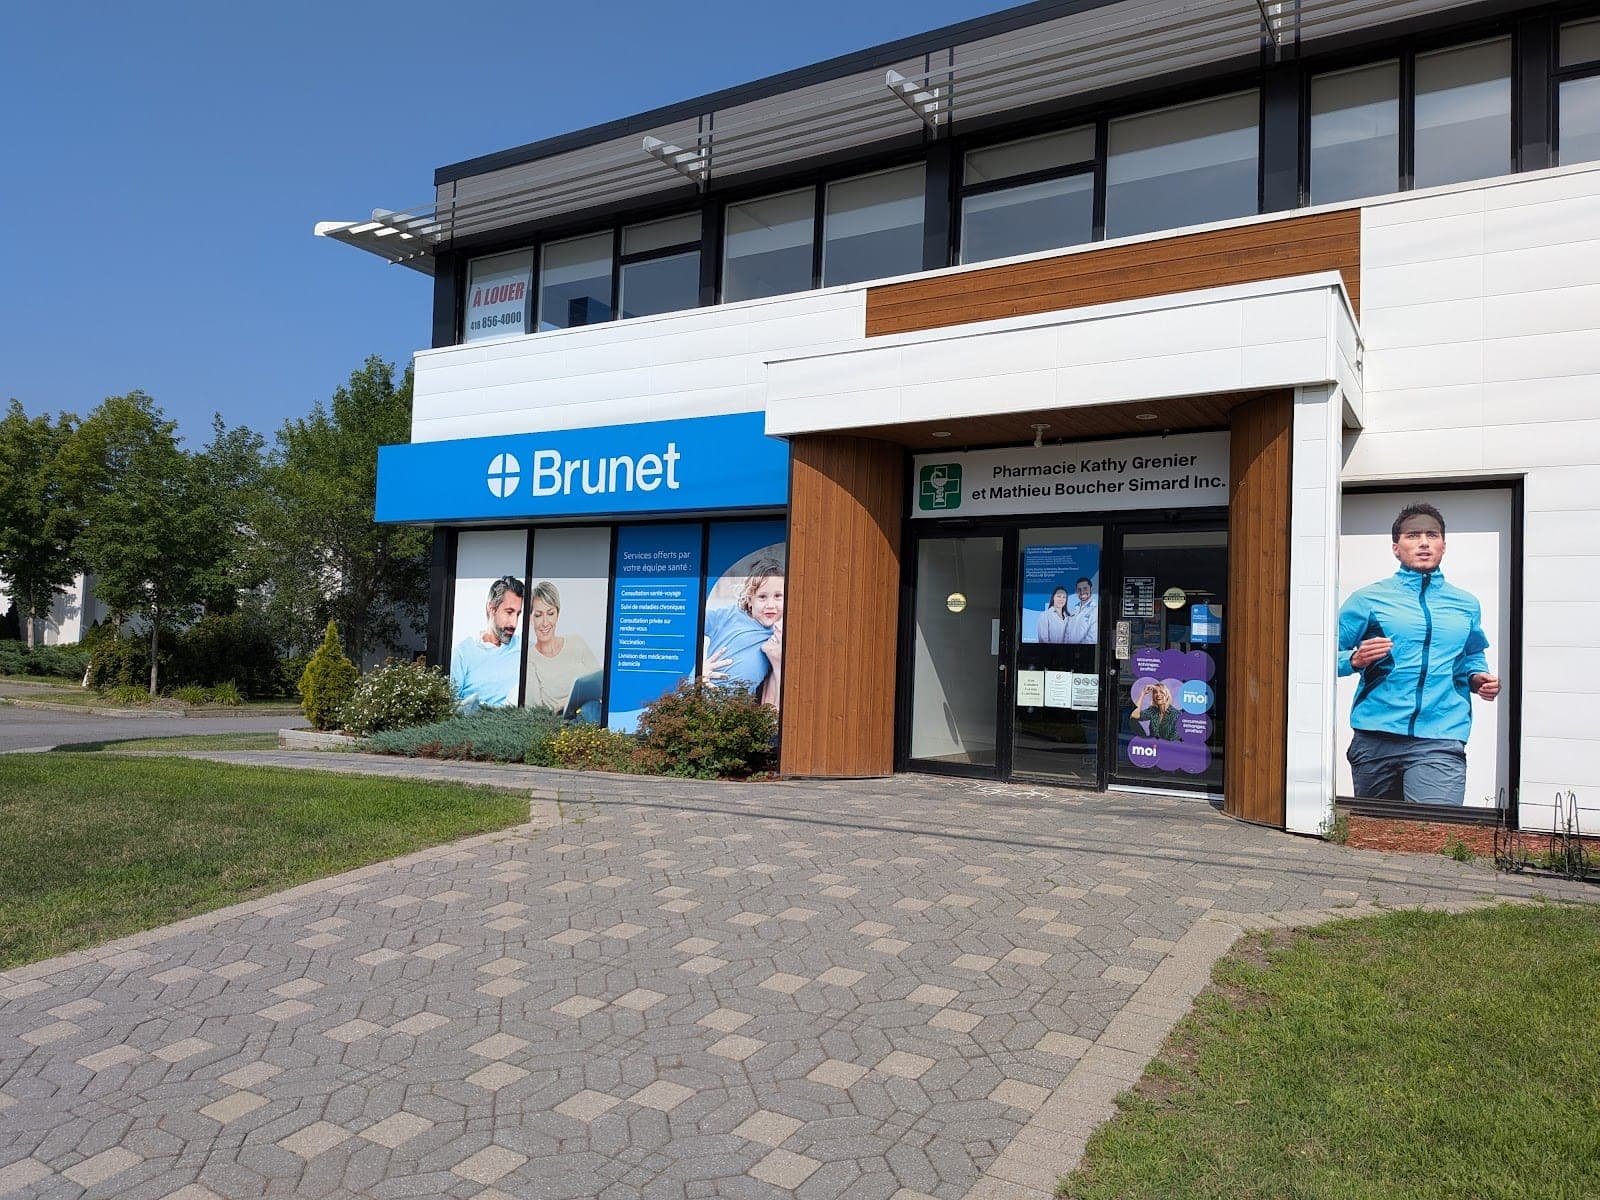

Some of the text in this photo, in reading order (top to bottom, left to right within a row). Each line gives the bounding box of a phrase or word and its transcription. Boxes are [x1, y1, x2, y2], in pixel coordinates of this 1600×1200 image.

[472, 281, 525, 308] À LOUER
[482, 311, 522, 329] 856-4000
[532, 442, 681, 497] Brunet
[992, 453, 1198, 479] Pharmacie Kathy Grenier
[971, 474, 1226, 500] et Mathieu Boucher Simard Inc.
[623, 550, 691, 560] Services offerts par
[623, 564, 641, 572] votre
[642, 563, 667, 573] équipe
[667, 563, 688, 571] santé
[1183, 693, 1209, 705] moi
[1131, 743, 1157, 757] moi
